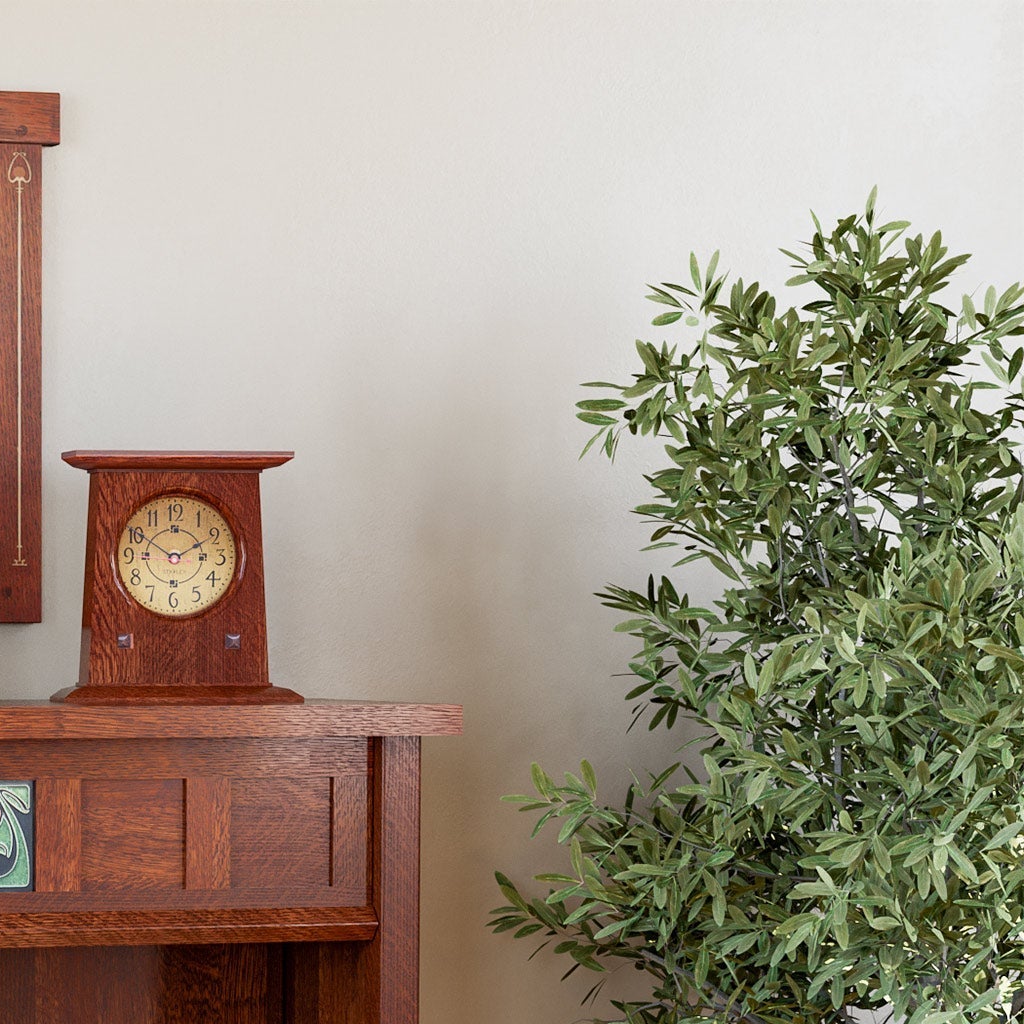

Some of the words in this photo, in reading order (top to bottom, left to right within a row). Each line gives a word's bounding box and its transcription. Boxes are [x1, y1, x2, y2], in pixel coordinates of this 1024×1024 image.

[147, 509, 158, 527] 11
[168, 503, 183, 522] 12
[196, 510, 201, 528] 1
[128, 526, 144, 544] 10
[209, 527, 220, 545] 2
[123, 547, 135, 565] 9
[215, 548, 226, 566] 3
[130, 568, 141, 586] 8
[205, 570, 221, 587] 4
[145, 585, 155, 602] 7
[168, 592, 179, 608] 6
[191, 585, 201, 603] 5
